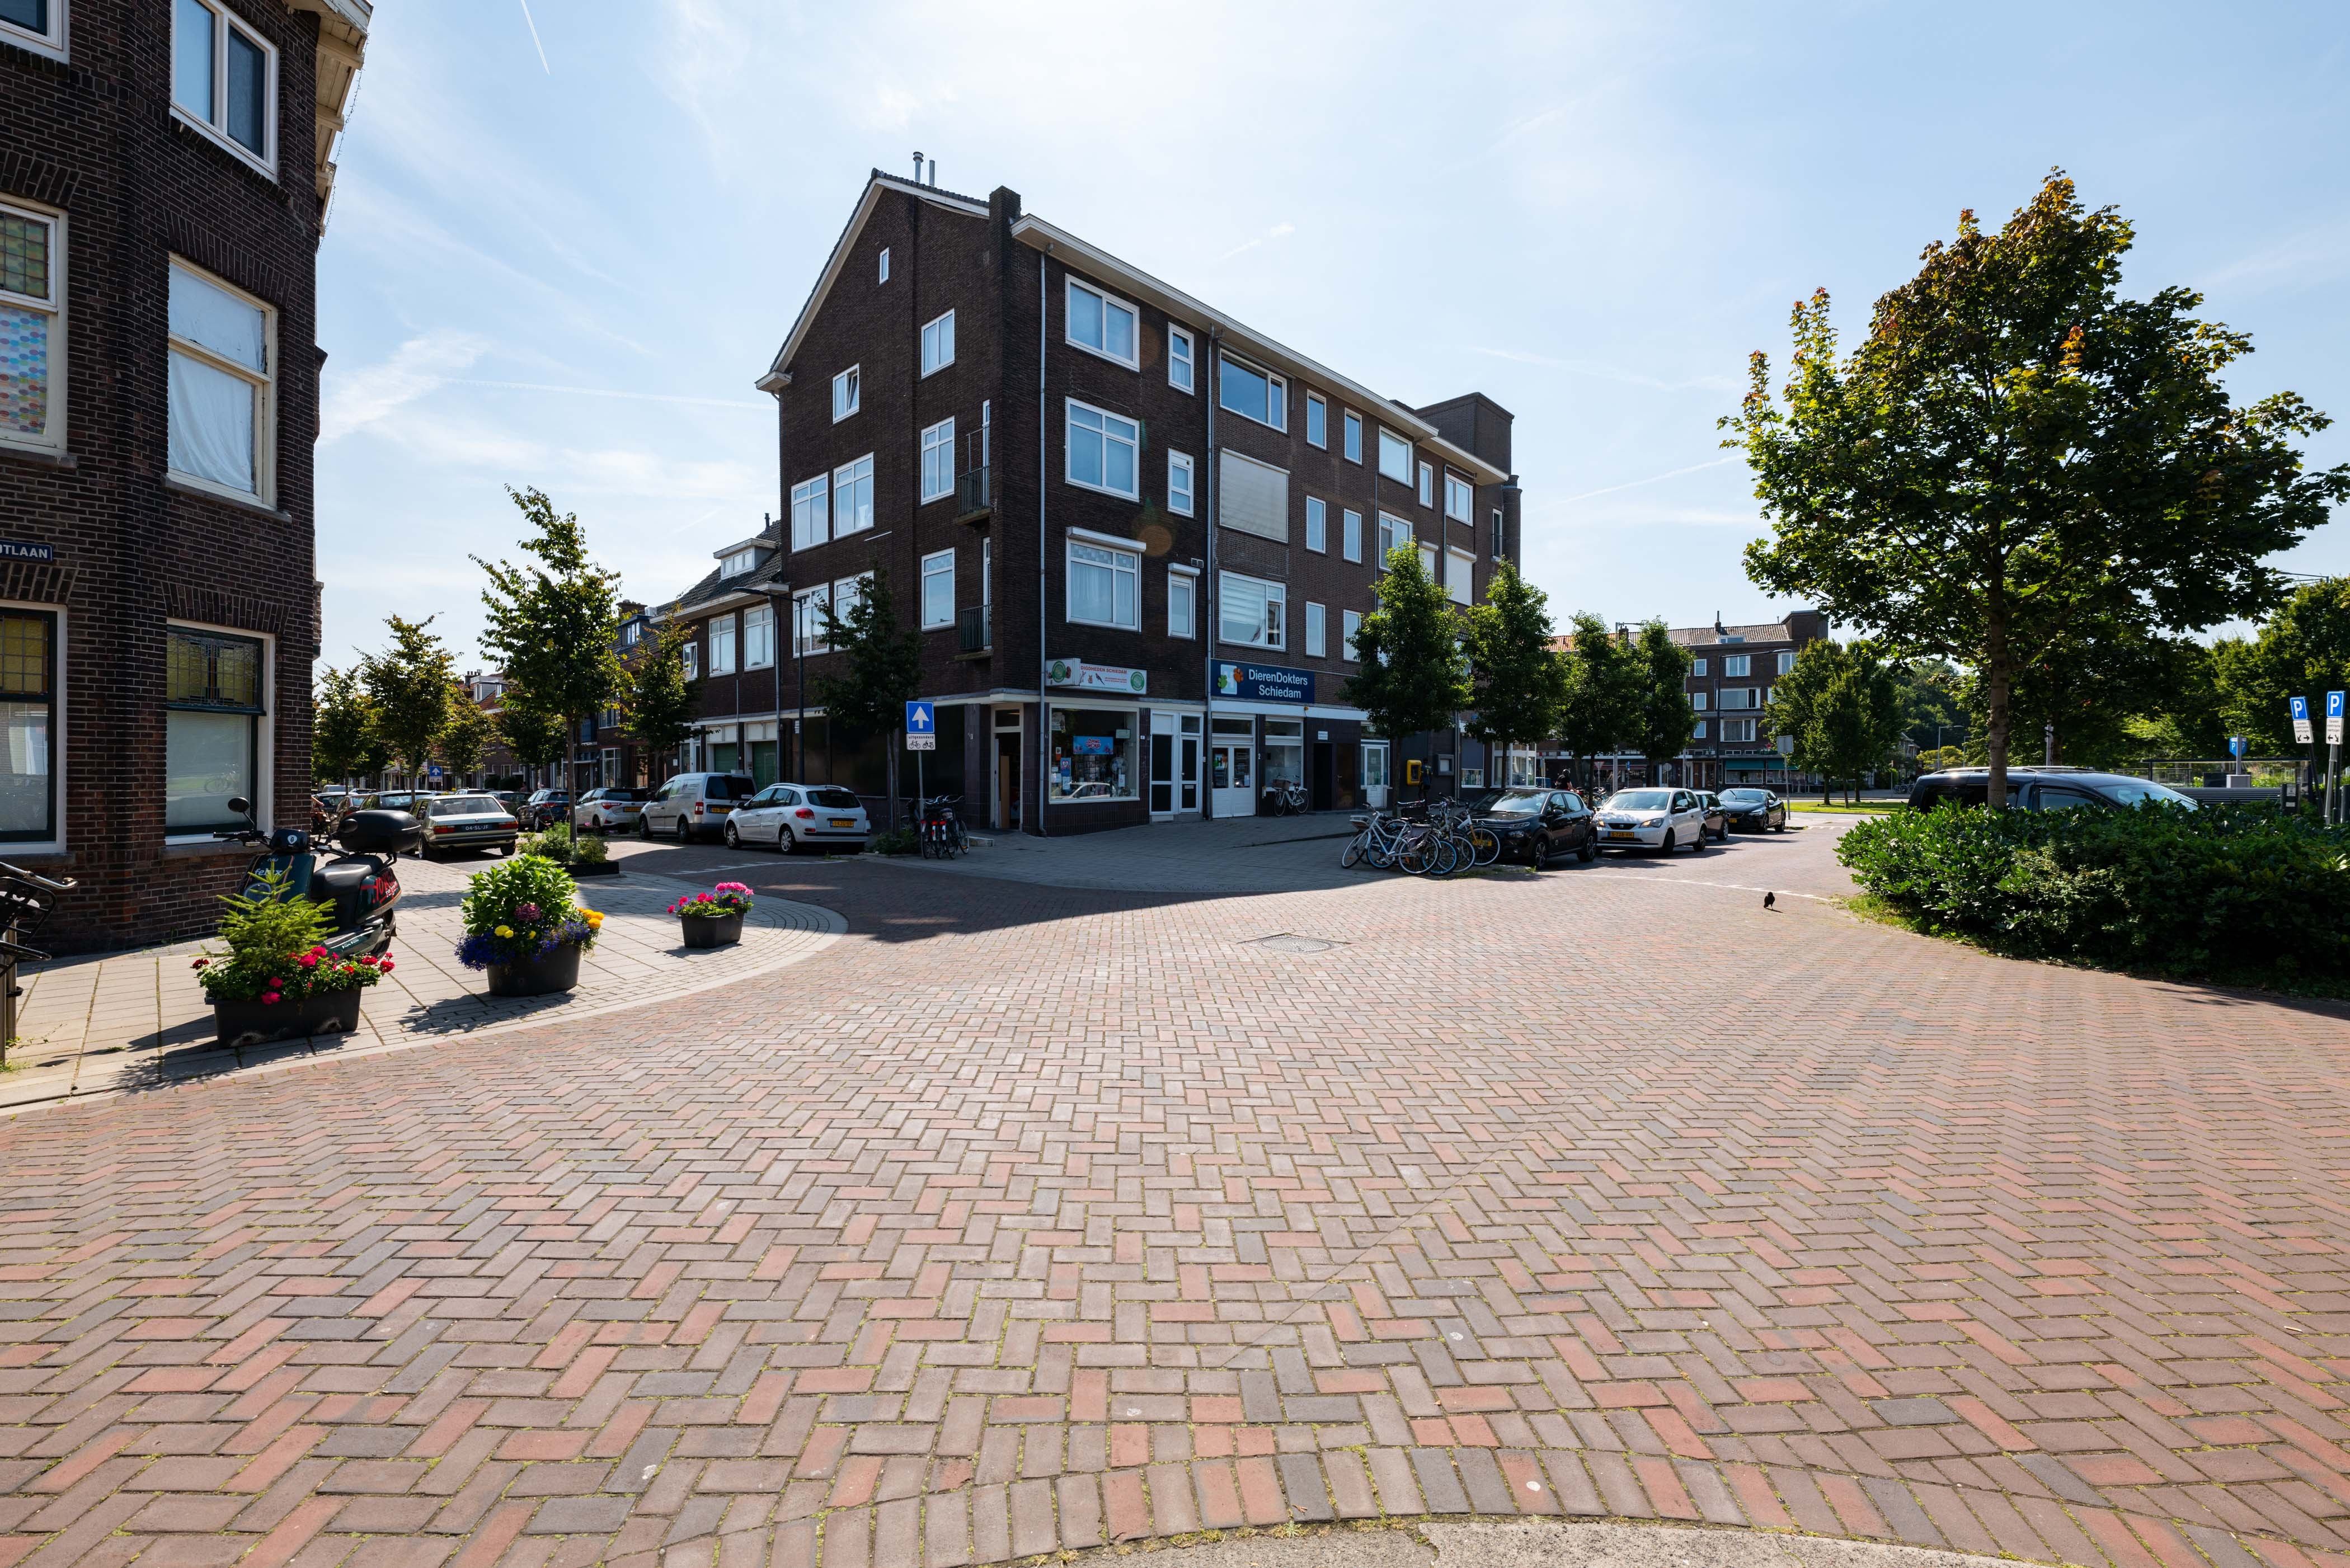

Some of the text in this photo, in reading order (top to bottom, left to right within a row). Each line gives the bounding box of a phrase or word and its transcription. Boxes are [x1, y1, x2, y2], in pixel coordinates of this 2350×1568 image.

[1248, 669, 1308, 685] DierenDokters
[1259, 685, 1301, 699] Schiedam
[2293, 700, 2302, 718] P
[2330, 695, 2340, 714] P
